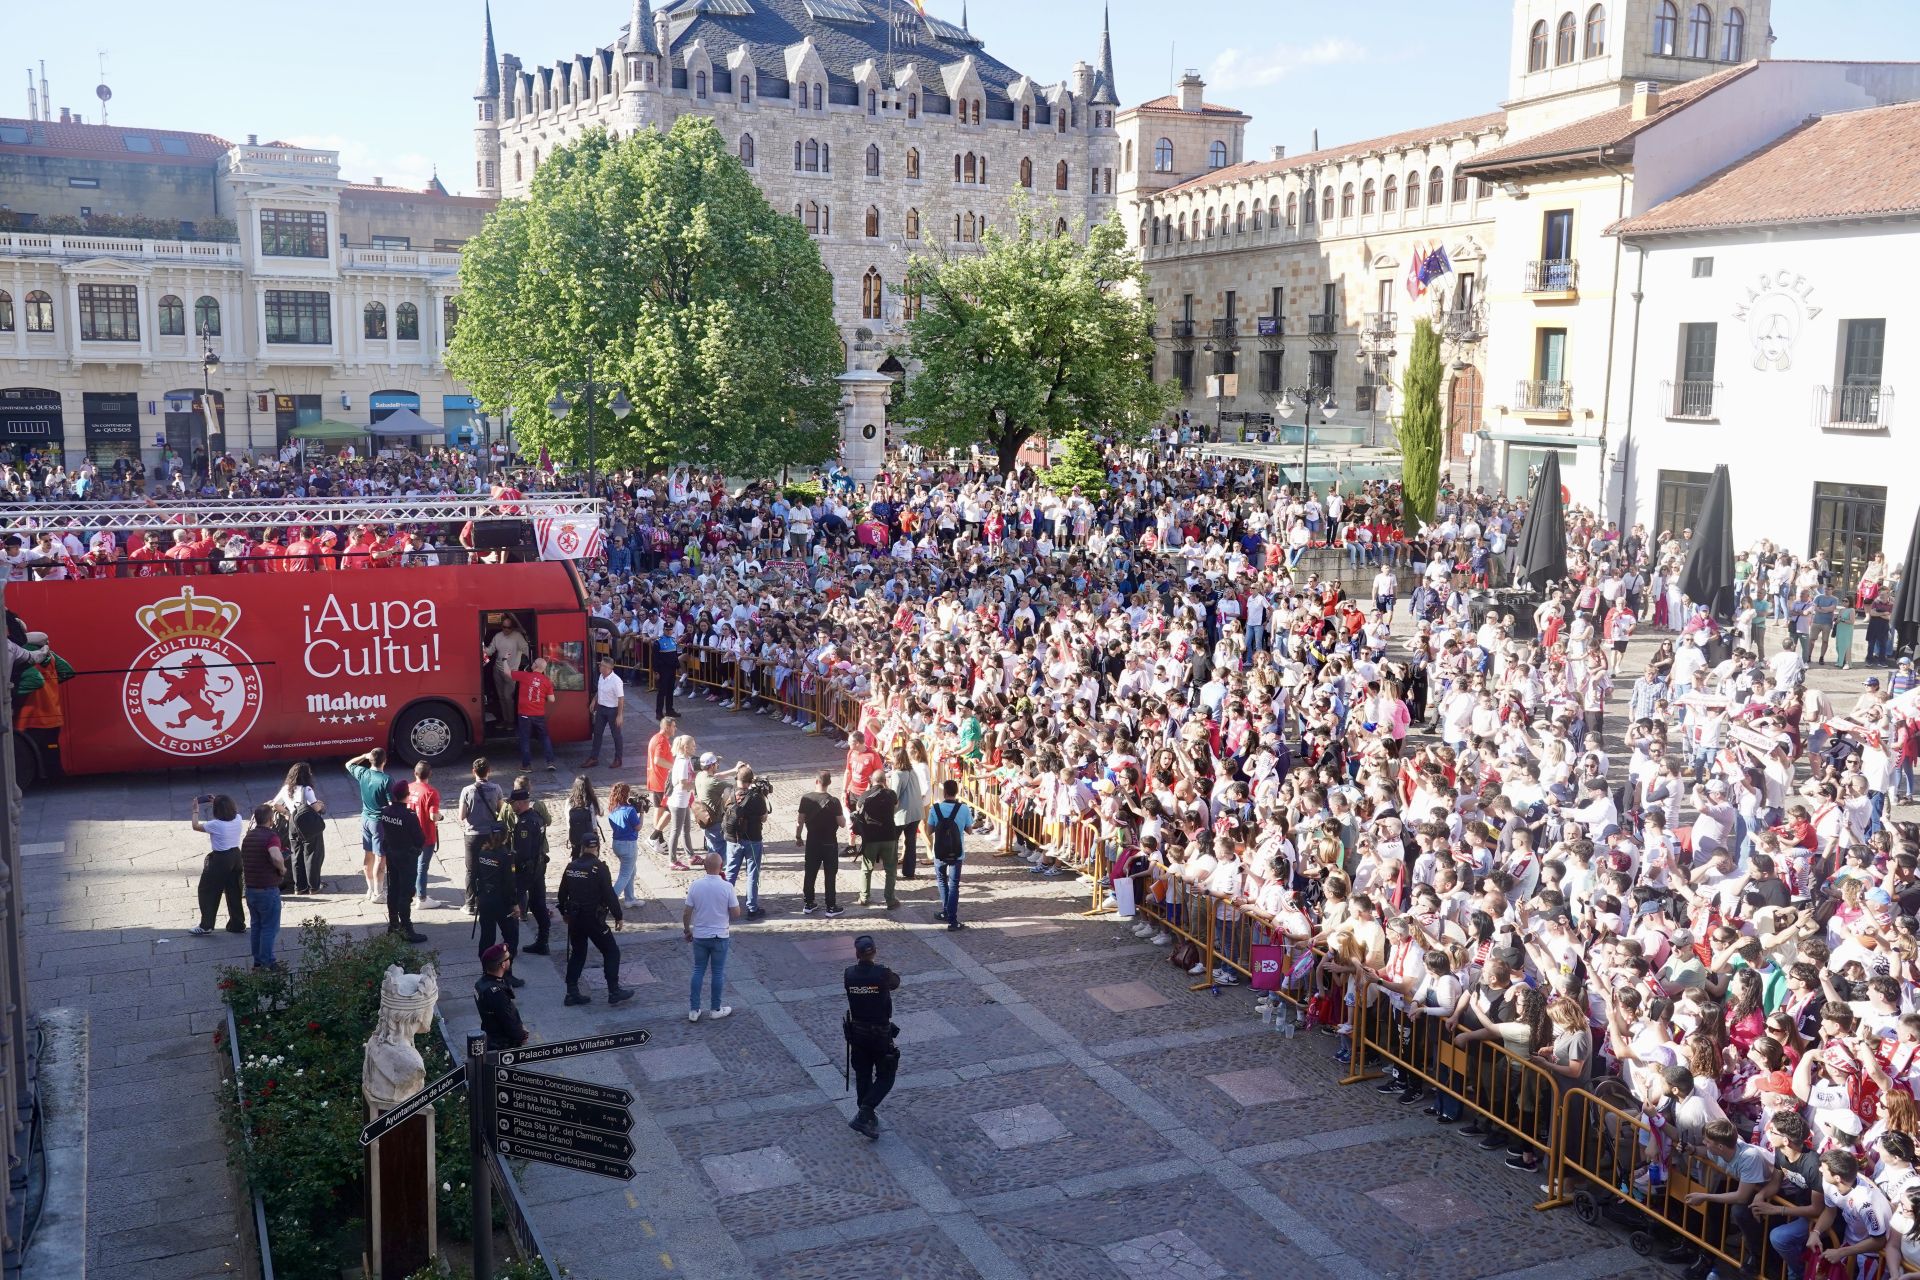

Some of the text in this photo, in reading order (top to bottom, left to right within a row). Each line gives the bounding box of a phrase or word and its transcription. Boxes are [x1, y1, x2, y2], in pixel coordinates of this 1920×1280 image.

[1731, 268, 1823, 322] MARCELA
[303, 593, 438, 643] ¡Aupa
[149, 636, 229, 661] CULTURAL
[303, 633, 441, 678] Cultu!
[128, 682, 142, 715] 1923
[245, 674, 257, 707] 1923
[305, 691, 387, 713] Mahou
[159, 732, 234, 752] LEONESA
[381, 814, 403, 826] POLICÍA
[519, 1050, 551, 1060] Palacio
[565, 1043, 578, 1052] los
[579, 1038, 615, 1049] Villafañe
[512, 1074, 544, 1085] Convento
[544, 1079, 599, 1096] Concepcionistas
[385, 1078, 453, 1126] Ayuntamiento de León
[512, 1091, 577, 1110] Iglesia Ntra. Sra.
[512, 1100, 562, 1117] del Mercado
[513, 1117, 533, 1129] Plaza
[533, 1120, 548, 1132] Sta.
[562, 1127, 574, 1137] del
[575, 1131, 603, 1143] Camino
[513, 1127, 573, 1147] (Plaza del Grano)
[514, 1144, 553, 1160] Convento
[553, 1152, 597, 1169] Carbajalas
